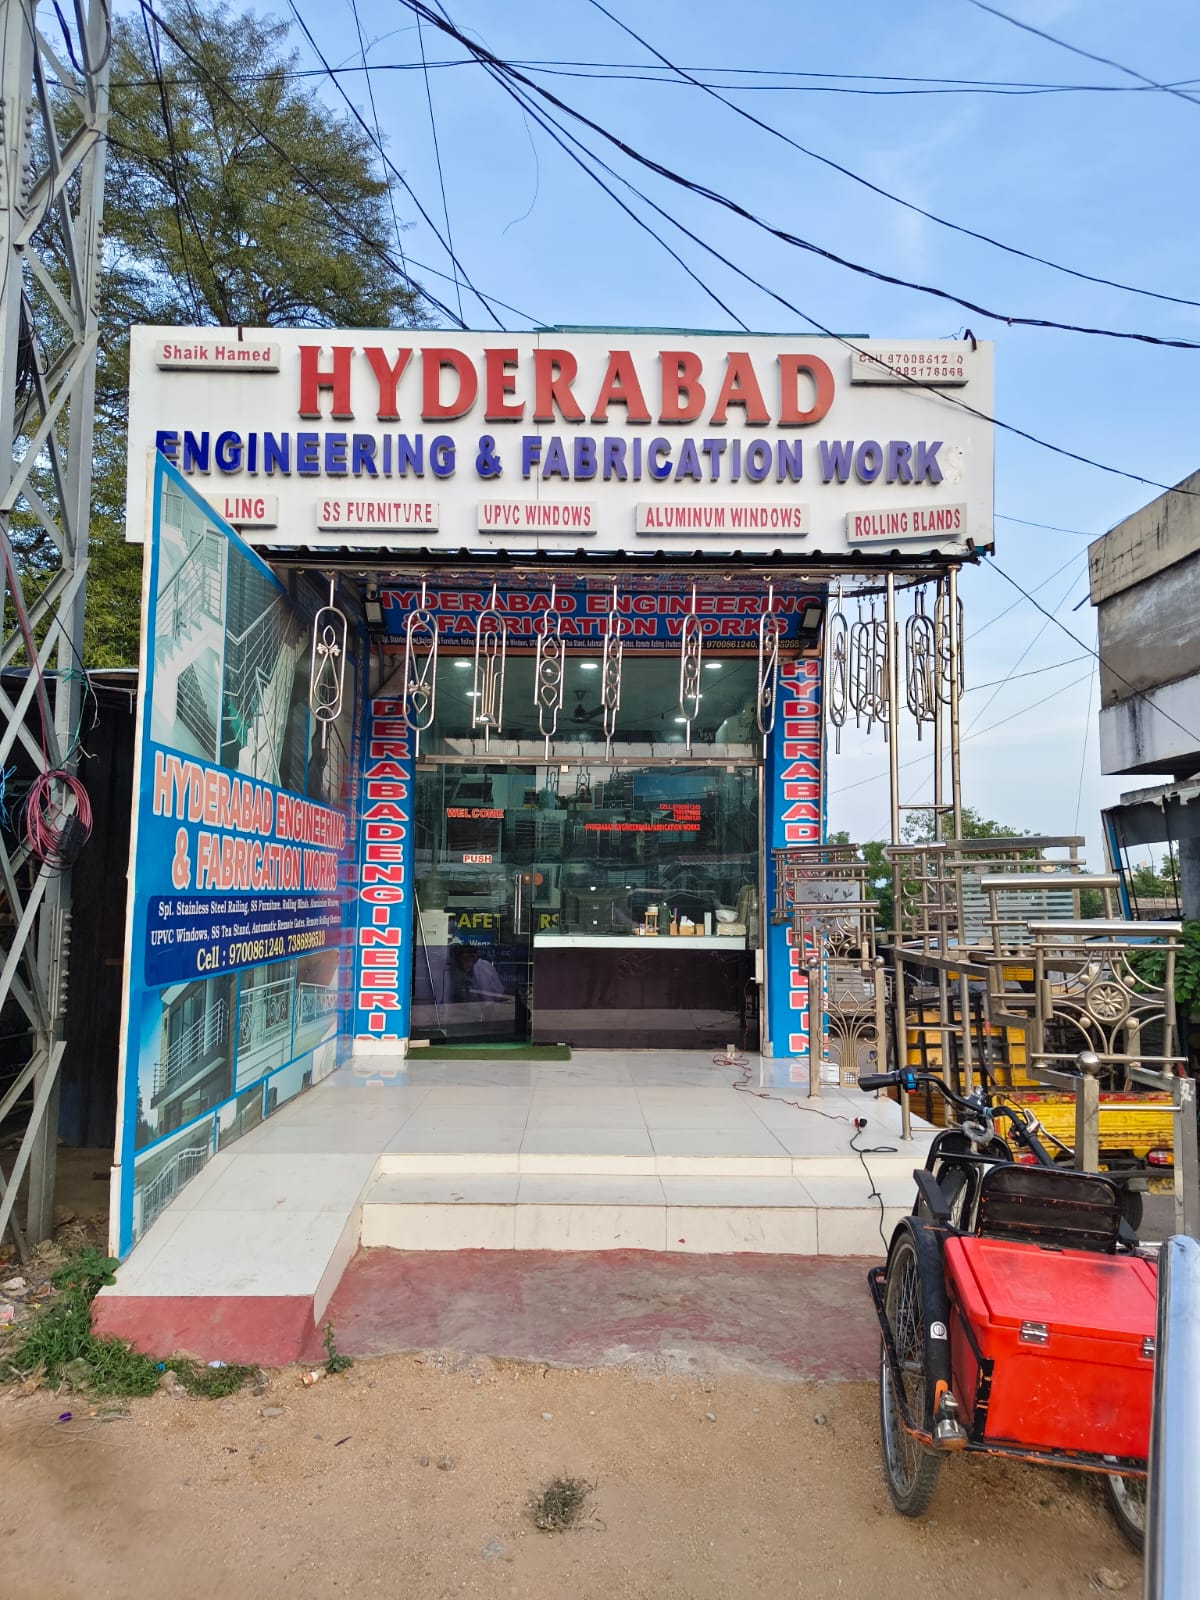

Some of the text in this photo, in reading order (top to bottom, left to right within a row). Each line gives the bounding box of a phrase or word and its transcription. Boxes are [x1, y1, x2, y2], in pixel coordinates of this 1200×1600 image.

[162, 344, 271, 362] Shaik Hamed
[297, 345, 836, 427] HYDERABAD
[155, 430, 944, 484] ENGINEERING & FABRICATION WORK
[322, 502, 433, 523] SS FURNITURE
[484, 504, 592, 526] UPVC WINDOWS
[645, 506, 802, 528] ALUMINUM WINDOWS
[854, 511, 909, 537] ROLLING
[436, 615, 657, 637] FABRICATION
[665, 617, 789, 637] WORKS
[152, 750, 273, 836] HYDERABAD
[275, 793, 346, 851] ENGINEERING
[446, 807, 505, 819] WELCOME
[171, 827, 338, 891] & FABRICATION WORKS
[463, 854, 492, 863] PUSH
[158, 901, 174, 920] Spl.
[176, 900, 209, 916] Stainless
[210, 900, 227, 914] Steel
[250, 899, 258, 912] SS
[151, 929, 175, 946] UPVC
[176, 927, 210, 942] Windows,
[211, 925, 220, 939] SS
[221, 925, 232, 938] Tea
[233, 922, 250, 937] Stand,
[196, 945, 220, 971] Cell
[229, 936, 286, 965] 9700861240,
